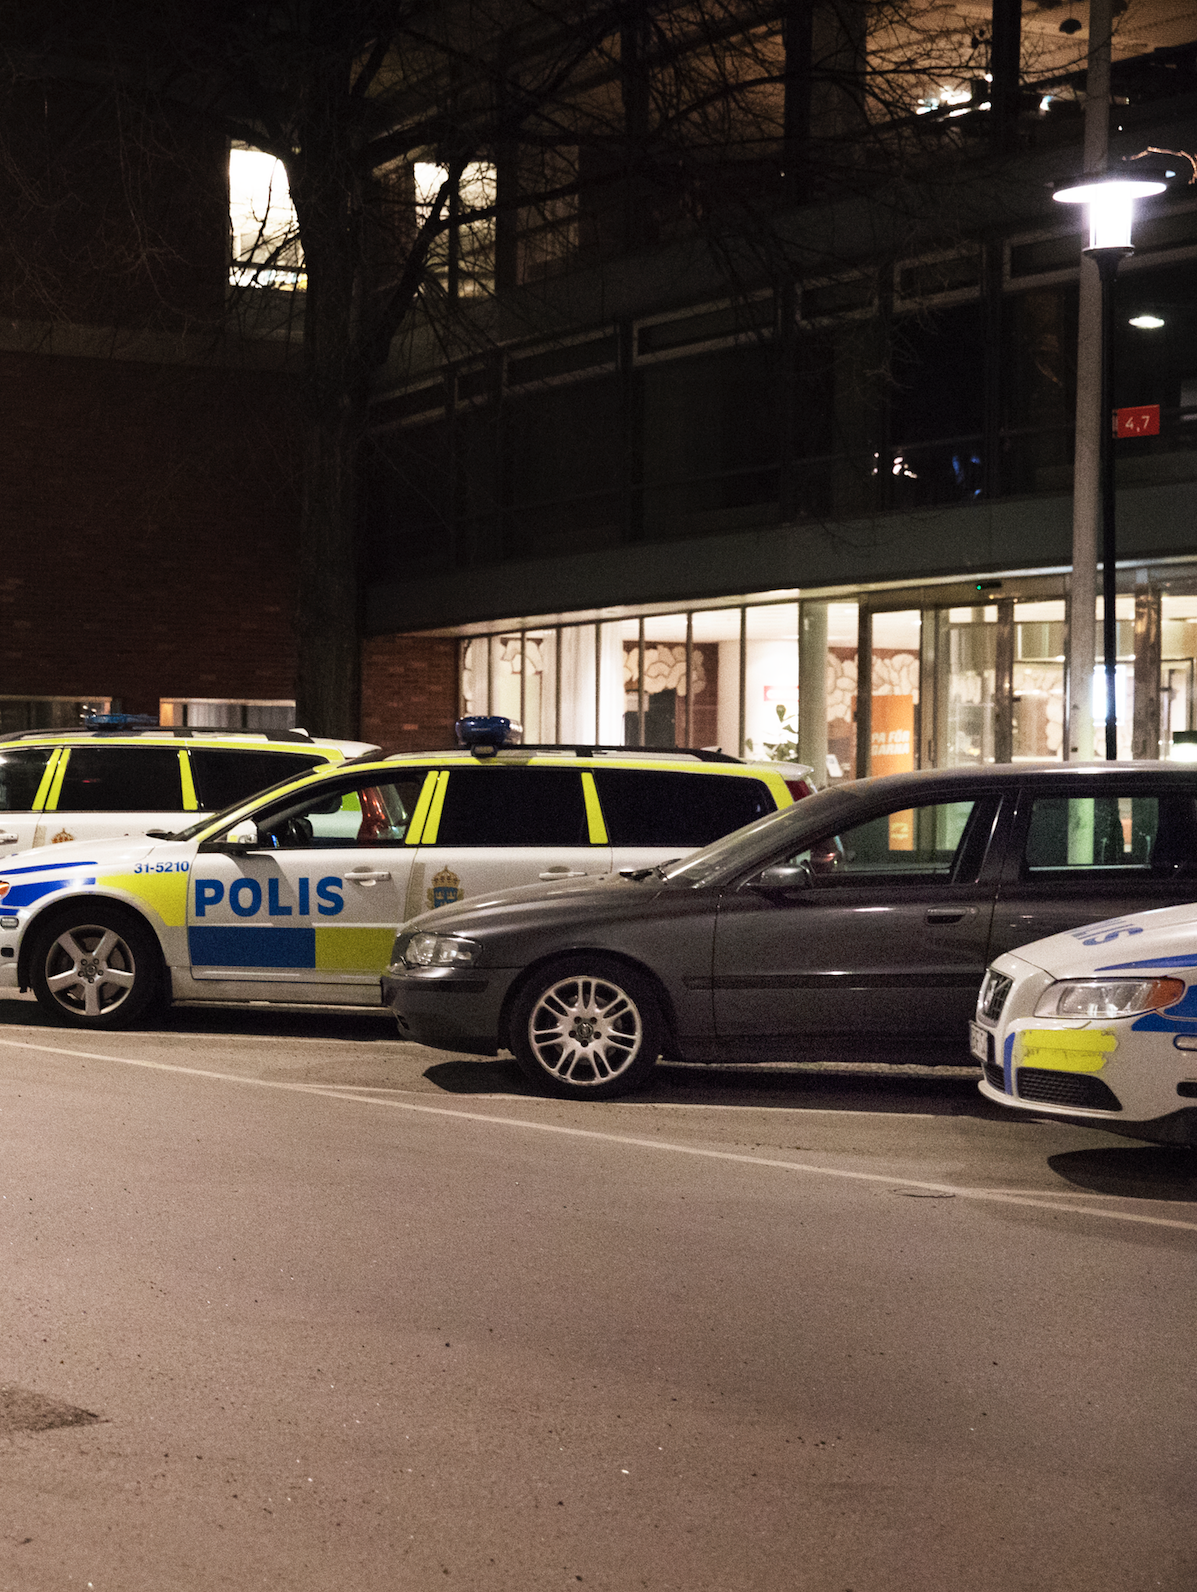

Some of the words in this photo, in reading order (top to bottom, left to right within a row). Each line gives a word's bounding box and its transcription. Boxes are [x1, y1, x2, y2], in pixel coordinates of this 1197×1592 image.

[1125, 415, 1151, 433] 4,7
[134, 860, 190, 874] 31-5210
[195, 876, 344, 918] POLIS
